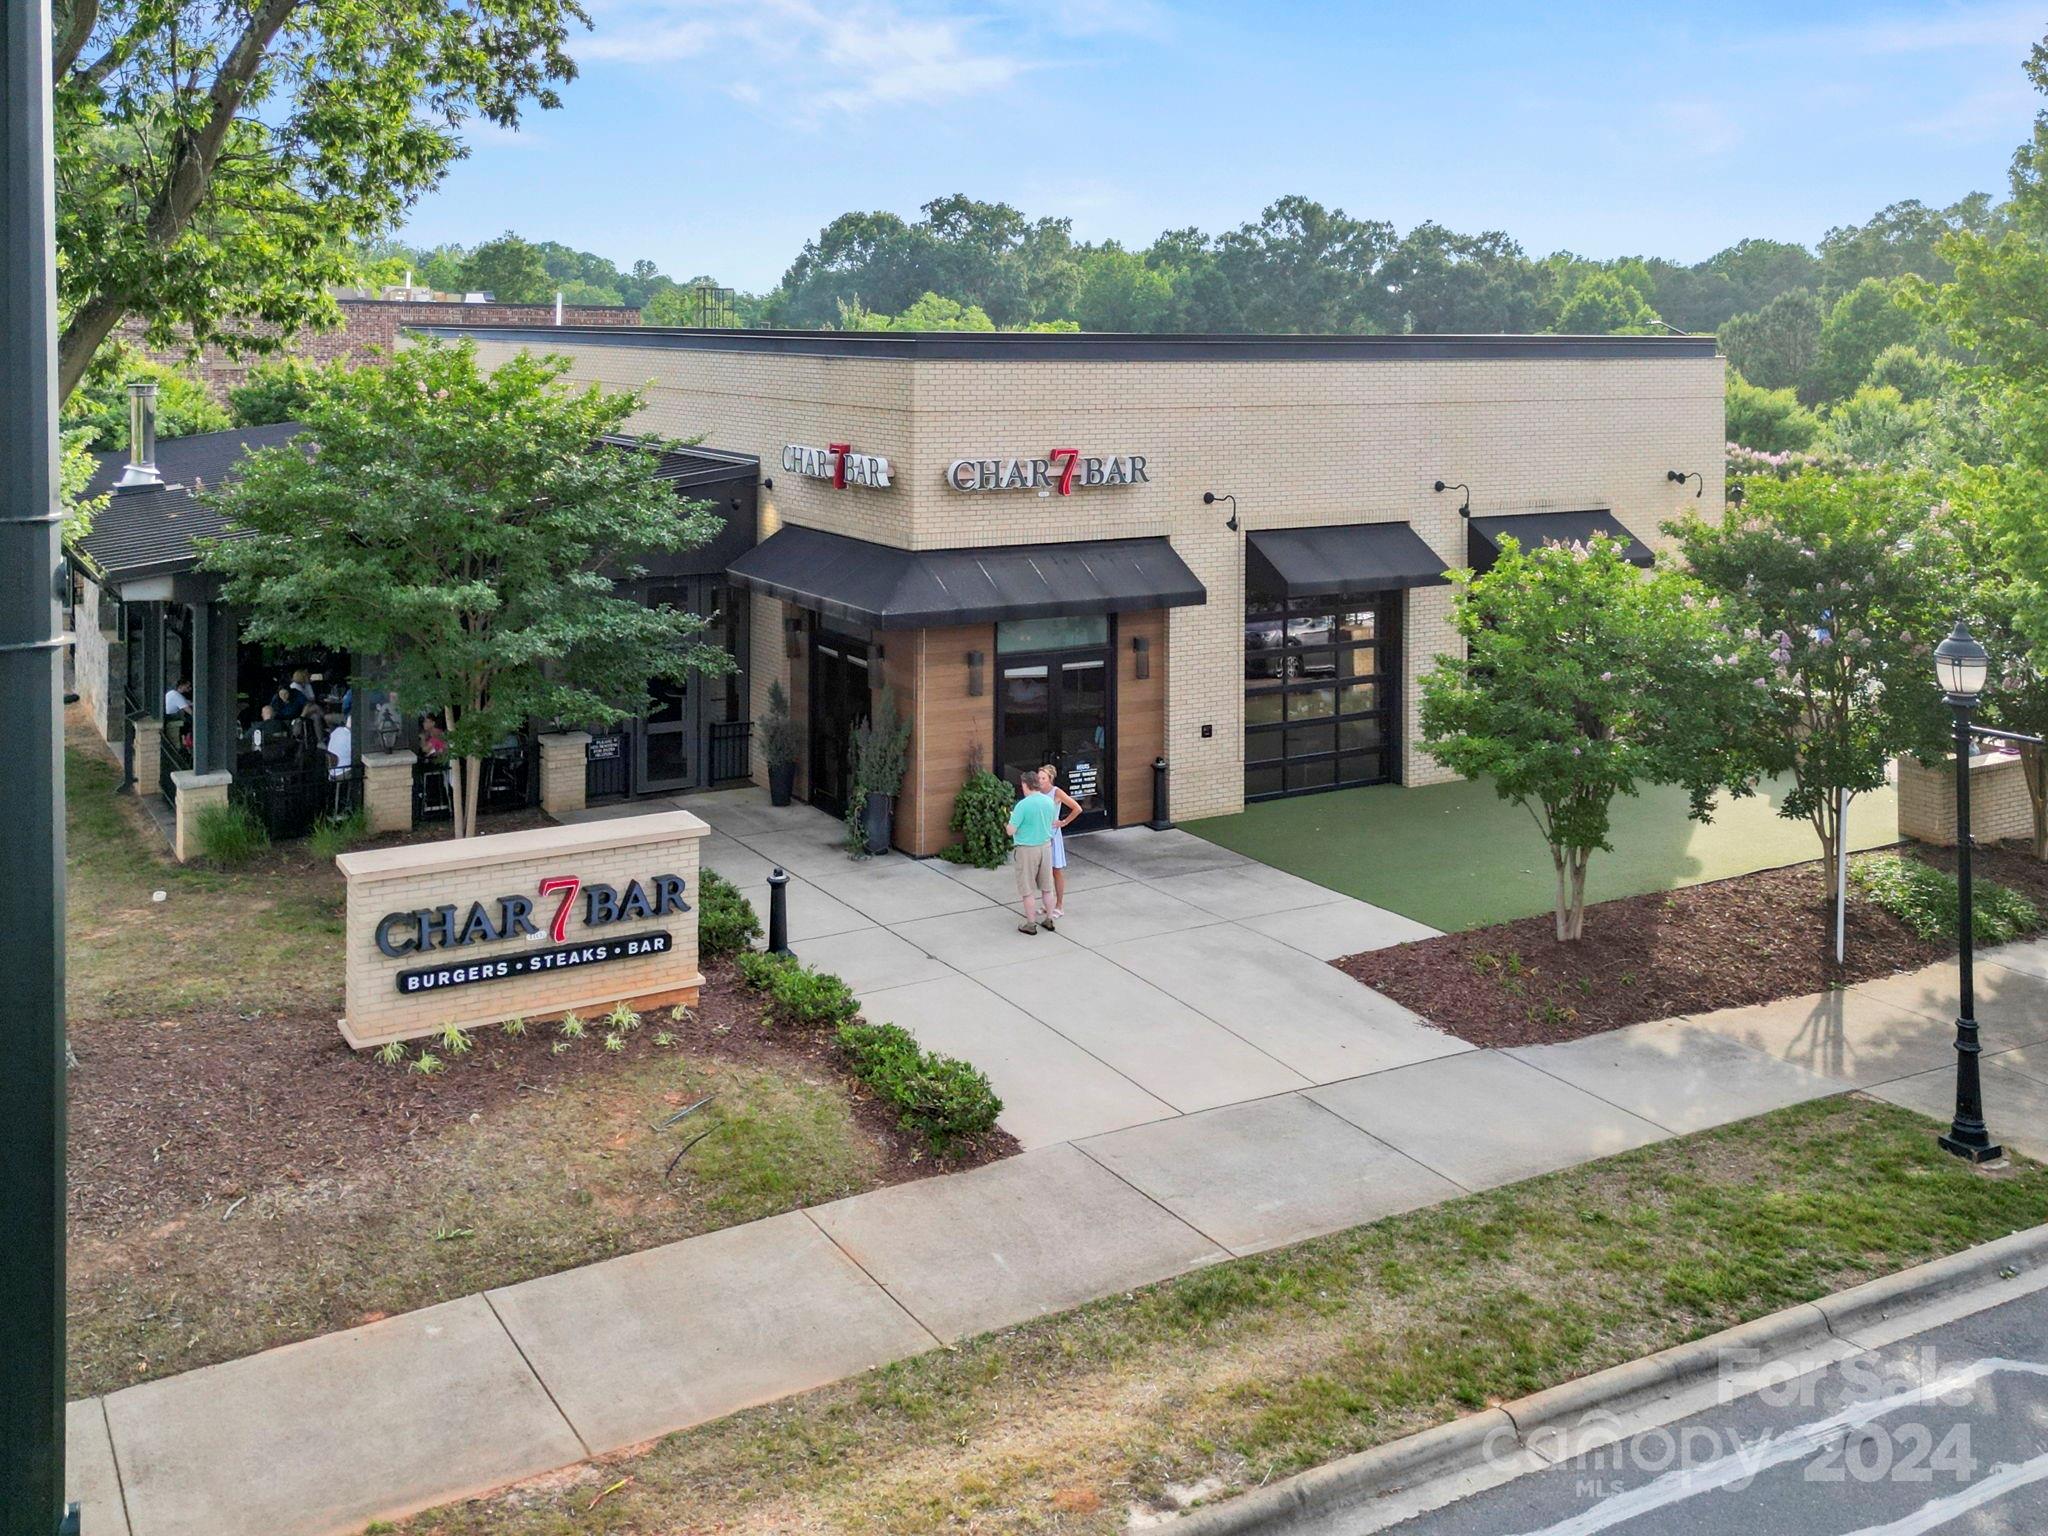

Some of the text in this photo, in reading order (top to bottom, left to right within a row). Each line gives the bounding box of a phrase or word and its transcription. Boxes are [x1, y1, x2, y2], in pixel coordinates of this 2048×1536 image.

[782, 443, 891, 490] CHAR 7 BAR
[949, 447, 1150, 497] CHAR 7 BAR
[375, 874, 692, 958] CHAR 7 BAR
[407, 936, 666, 991] BURGERS STEAKS BAR
